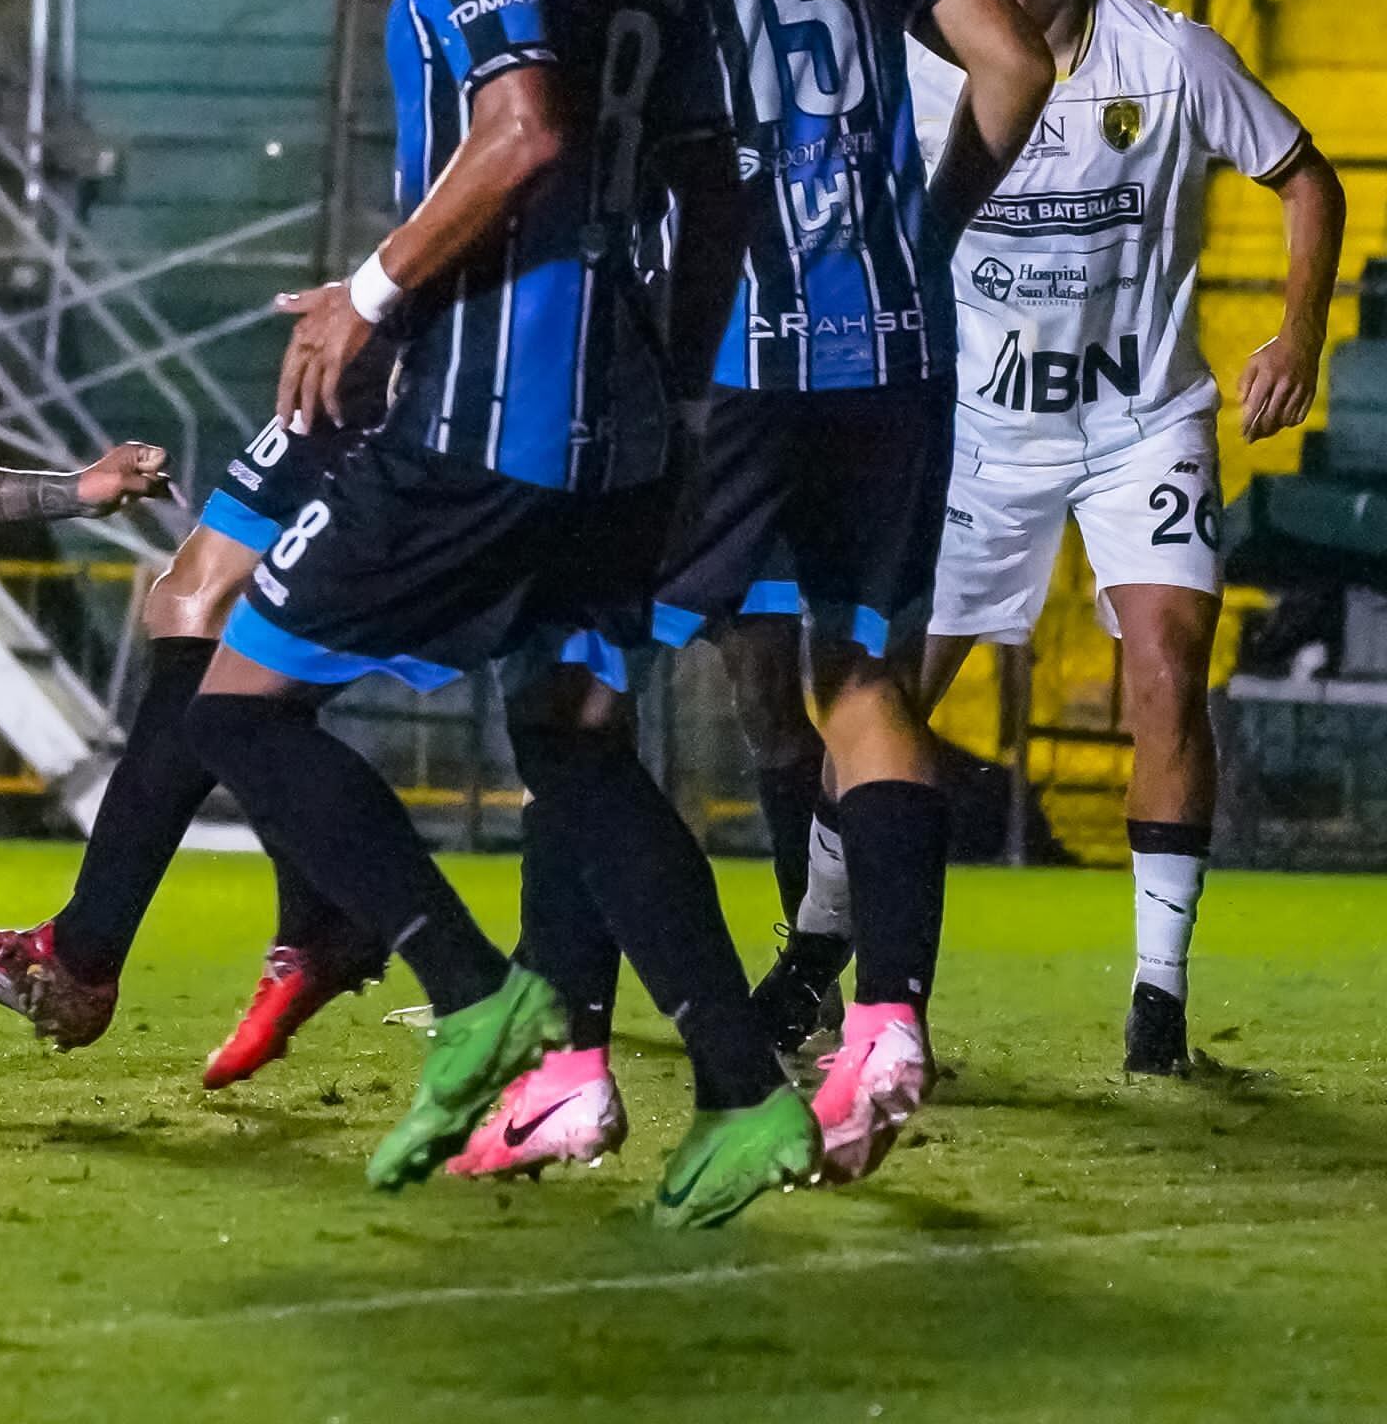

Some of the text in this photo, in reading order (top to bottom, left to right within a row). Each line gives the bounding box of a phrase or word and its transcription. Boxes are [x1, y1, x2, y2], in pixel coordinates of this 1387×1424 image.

[1037, 192, 1132, 220] BATERIAS
[1019, 263, 1088, 285] Hospital
[1016, 284, 1043, 298] San
[1048, 282, 1089, 300] Rafael
[1148, 482, 1224, 552] 26
[271, 499, 332, 570] 8
